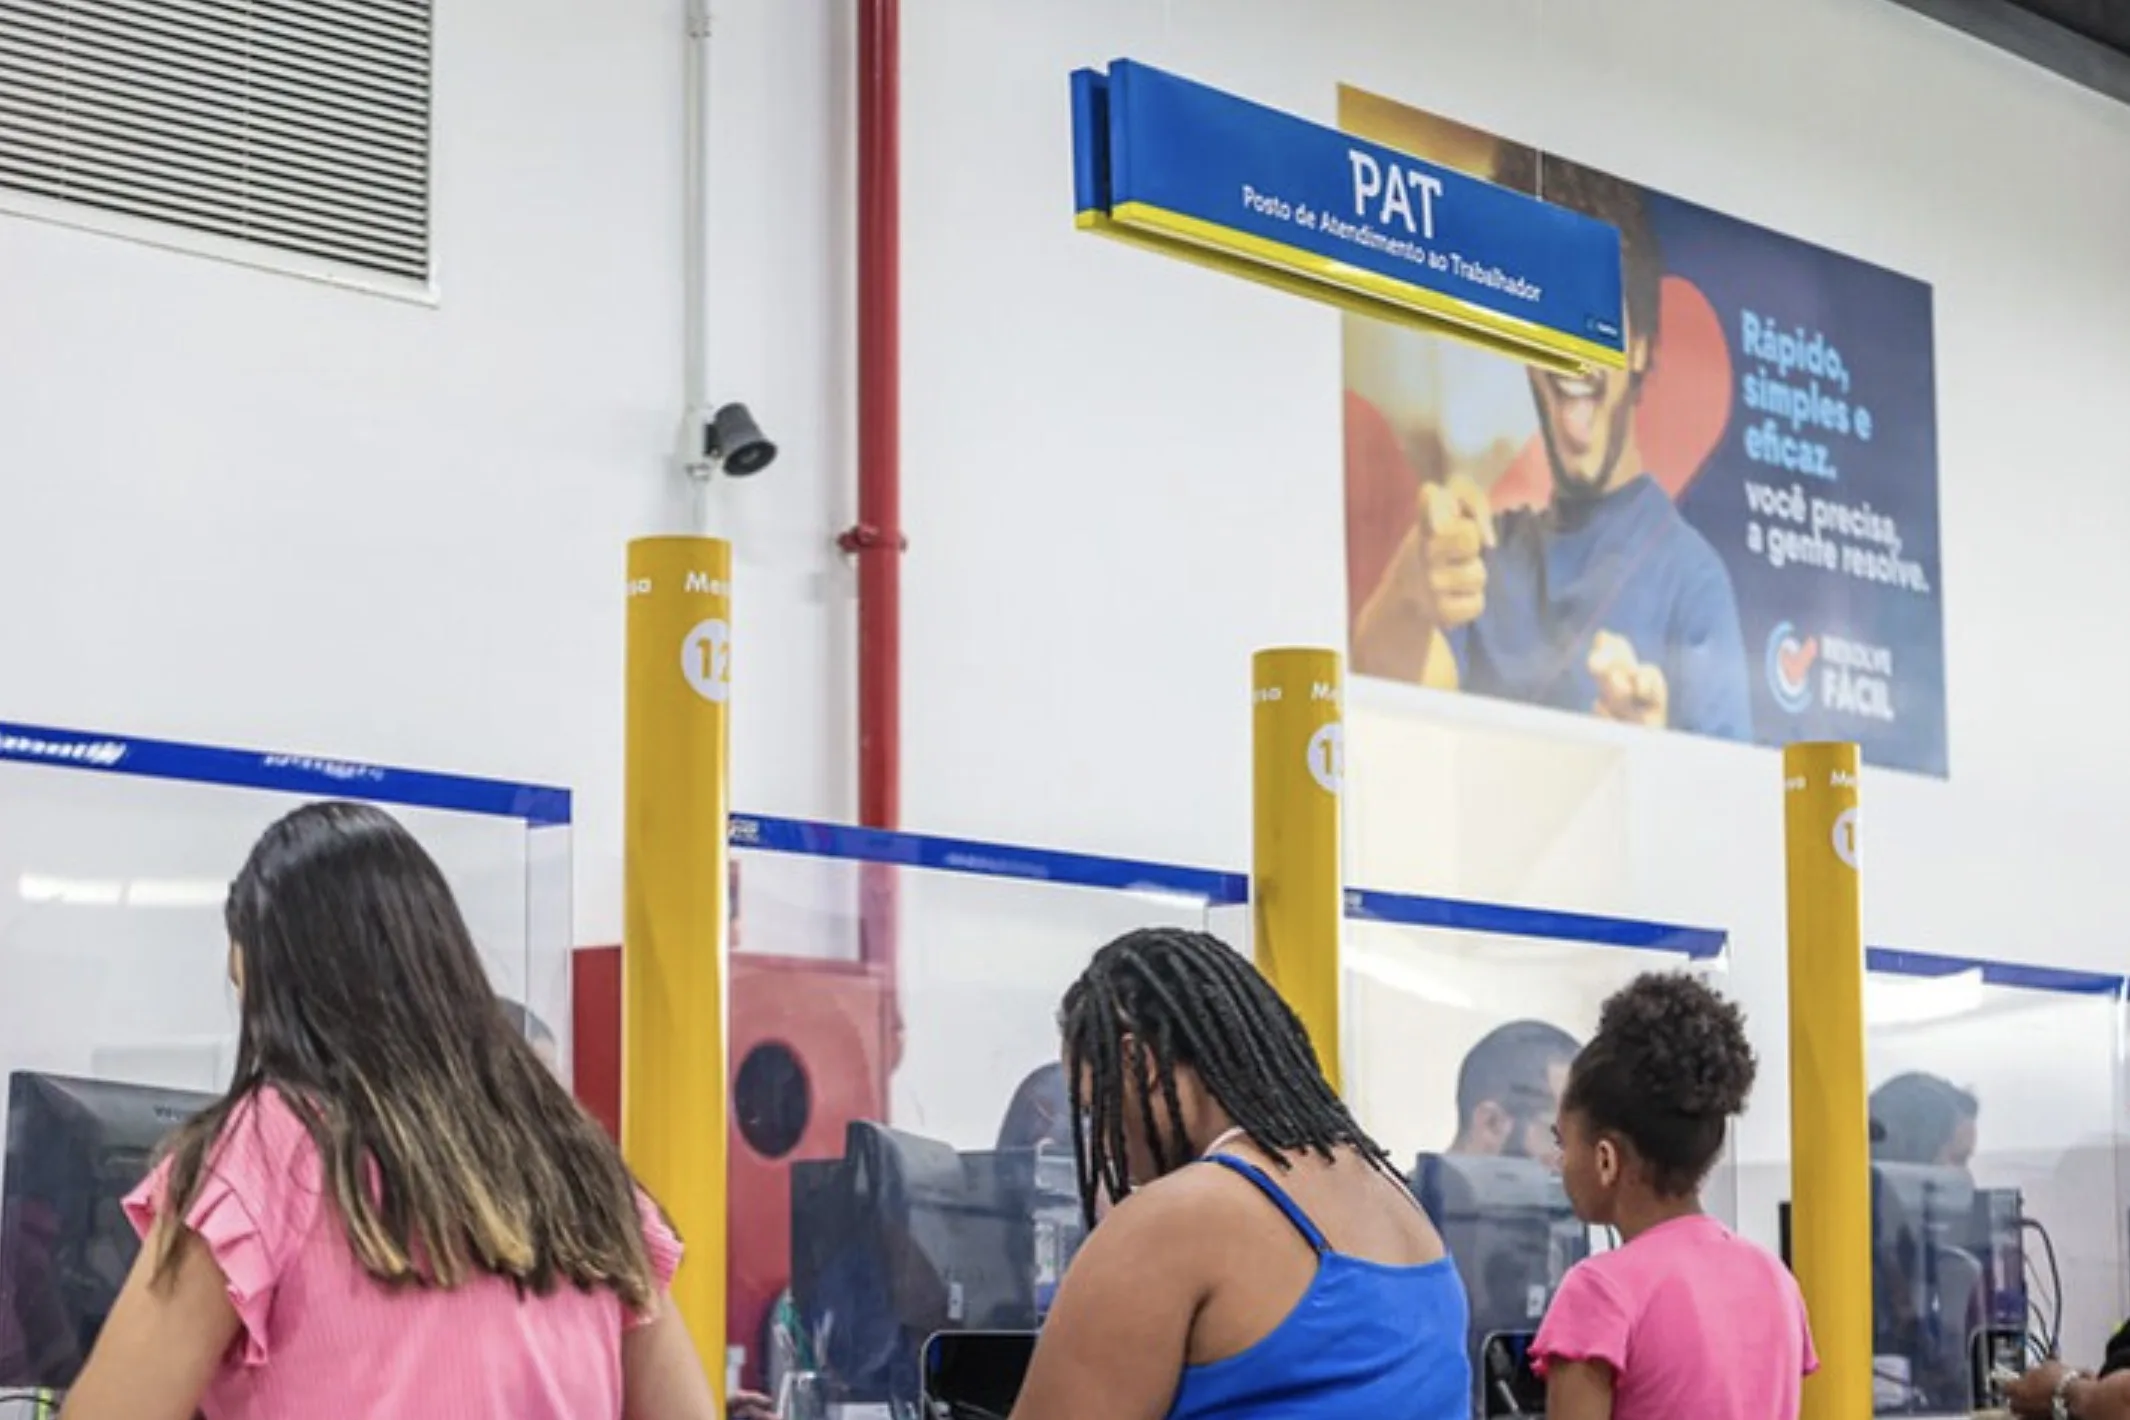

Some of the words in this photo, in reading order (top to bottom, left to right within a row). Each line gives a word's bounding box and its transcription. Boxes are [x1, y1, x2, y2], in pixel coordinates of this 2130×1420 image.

[1349, 149, 1443, 239] PAT
[1242, 184, 1291, 222] Posto
[1294, 204, 1317, 230] de
[1319, 210, 1424, 265] Atendimento
[1427, 249, 1449, 270] ao
[1449, 251, 1543, 303] Trabalhador
[1741, 309, 1850, 393] Rápido,
[1743, 365, 1850, 435] simples
[1853, 405, 1873, 441] e
[1744, 418, 1837, 481] eficaz.
[1744, 482, 1806, 524] você
[1747, 521, 1762, 553] a
[1767, 525, 1836, 570] gente
[1841, 543, 1930, 594] resolve.
